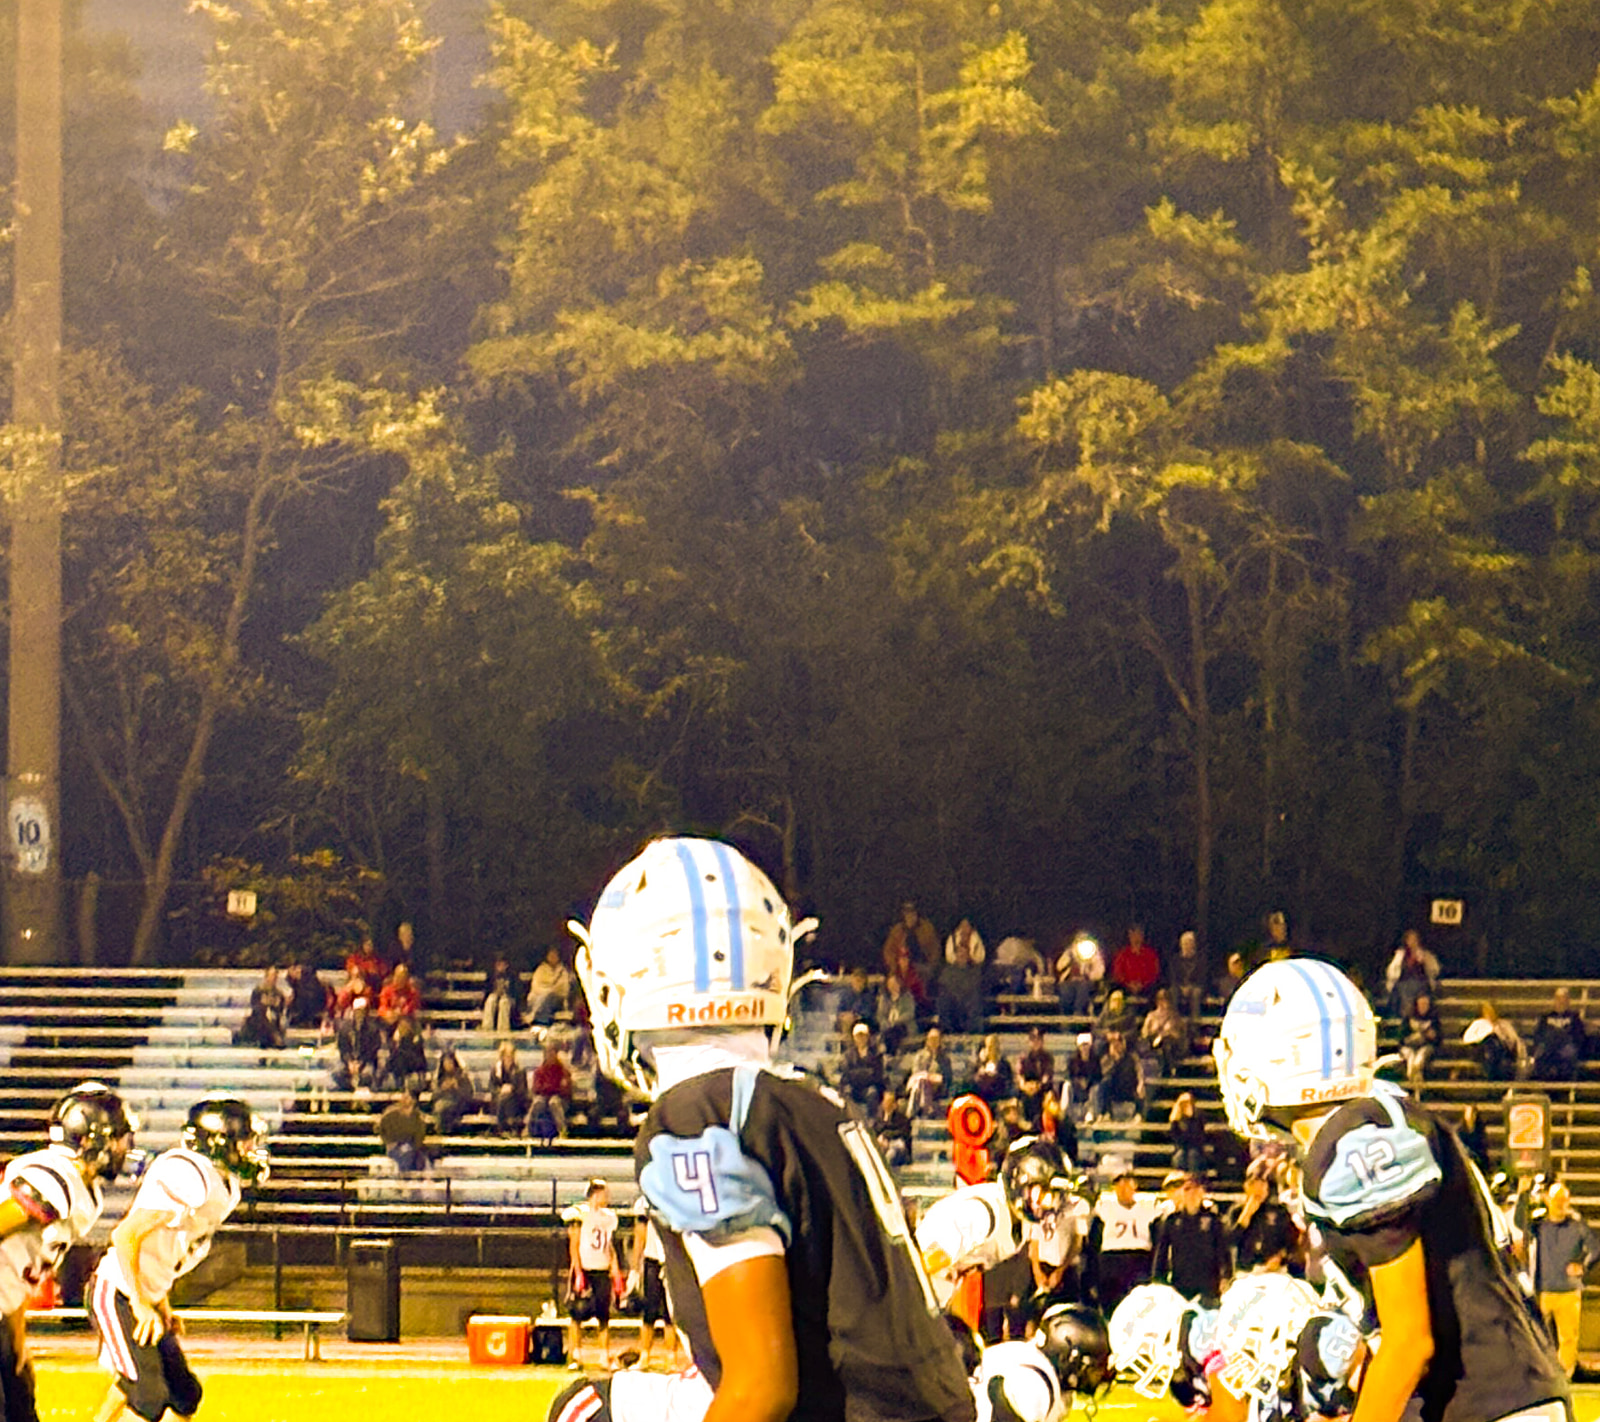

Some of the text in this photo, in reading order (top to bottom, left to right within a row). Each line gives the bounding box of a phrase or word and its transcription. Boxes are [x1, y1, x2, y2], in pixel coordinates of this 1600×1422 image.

[666, 998, 765, 1024] Riddell
[1508, 1103, 1544, 1149] 2
[672, 1150, 719, 1214] 4
[1344, 1136, 1403, 1191] 12
[591, 1226, 609, 1251] 31
